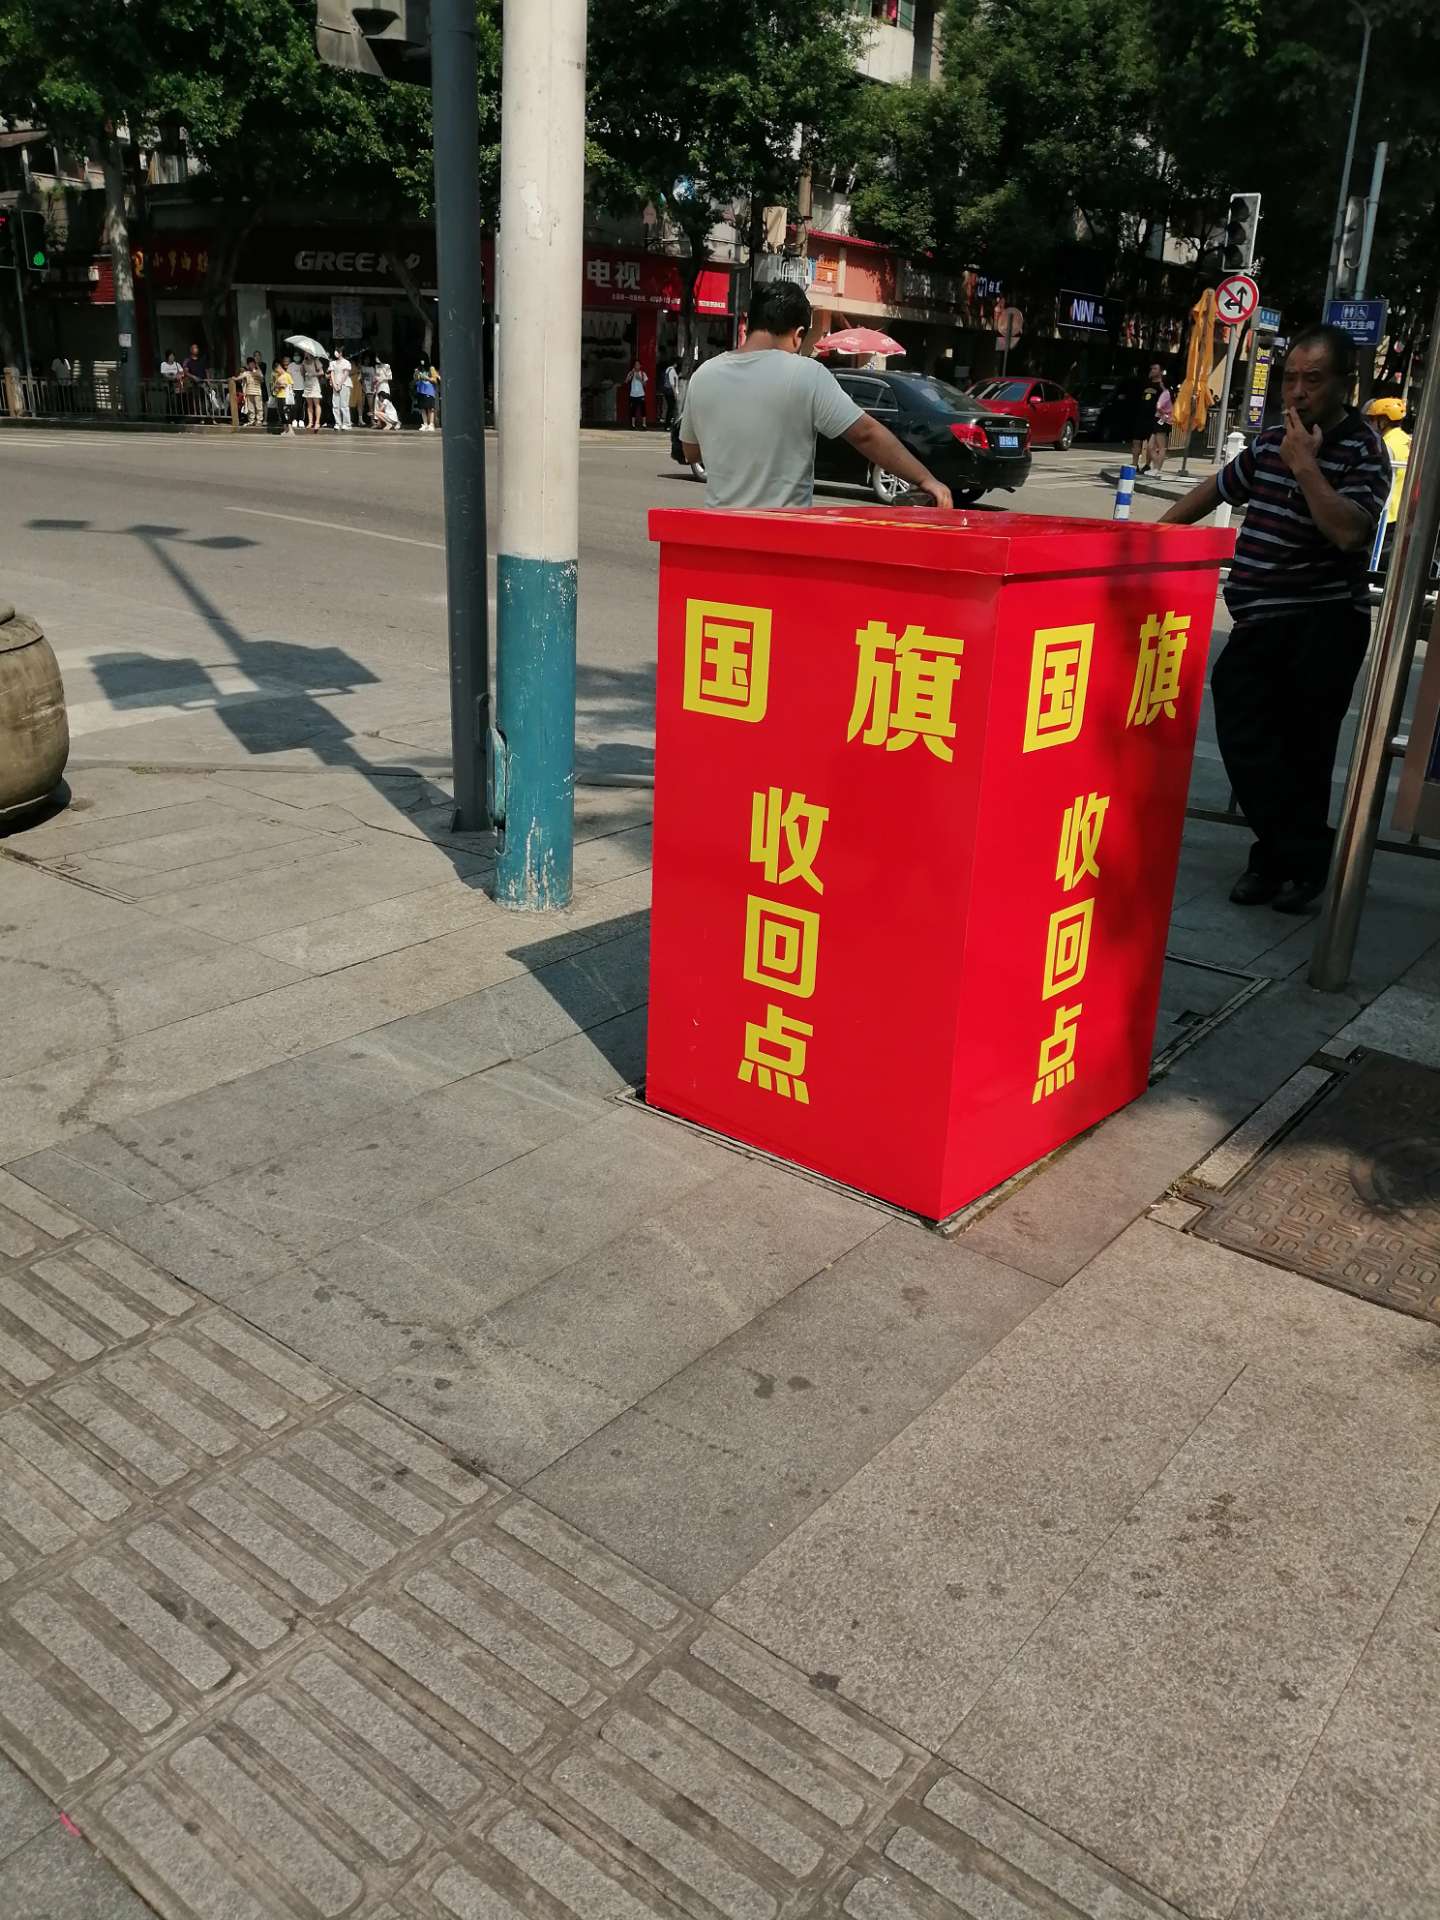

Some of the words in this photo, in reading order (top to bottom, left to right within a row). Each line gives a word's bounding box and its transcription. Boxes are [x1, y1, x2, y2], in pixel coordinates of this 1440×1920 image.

[293, 250, 376, 273] GREE
[586, 259, 641, 290] 电视
[682, 598, 965, 763] 国旗
[1022, 610, 1192, 753] 国旗
[737, 786, 830, 1105] 收回点
[1031, 791, 1110, 1104] 收回点
